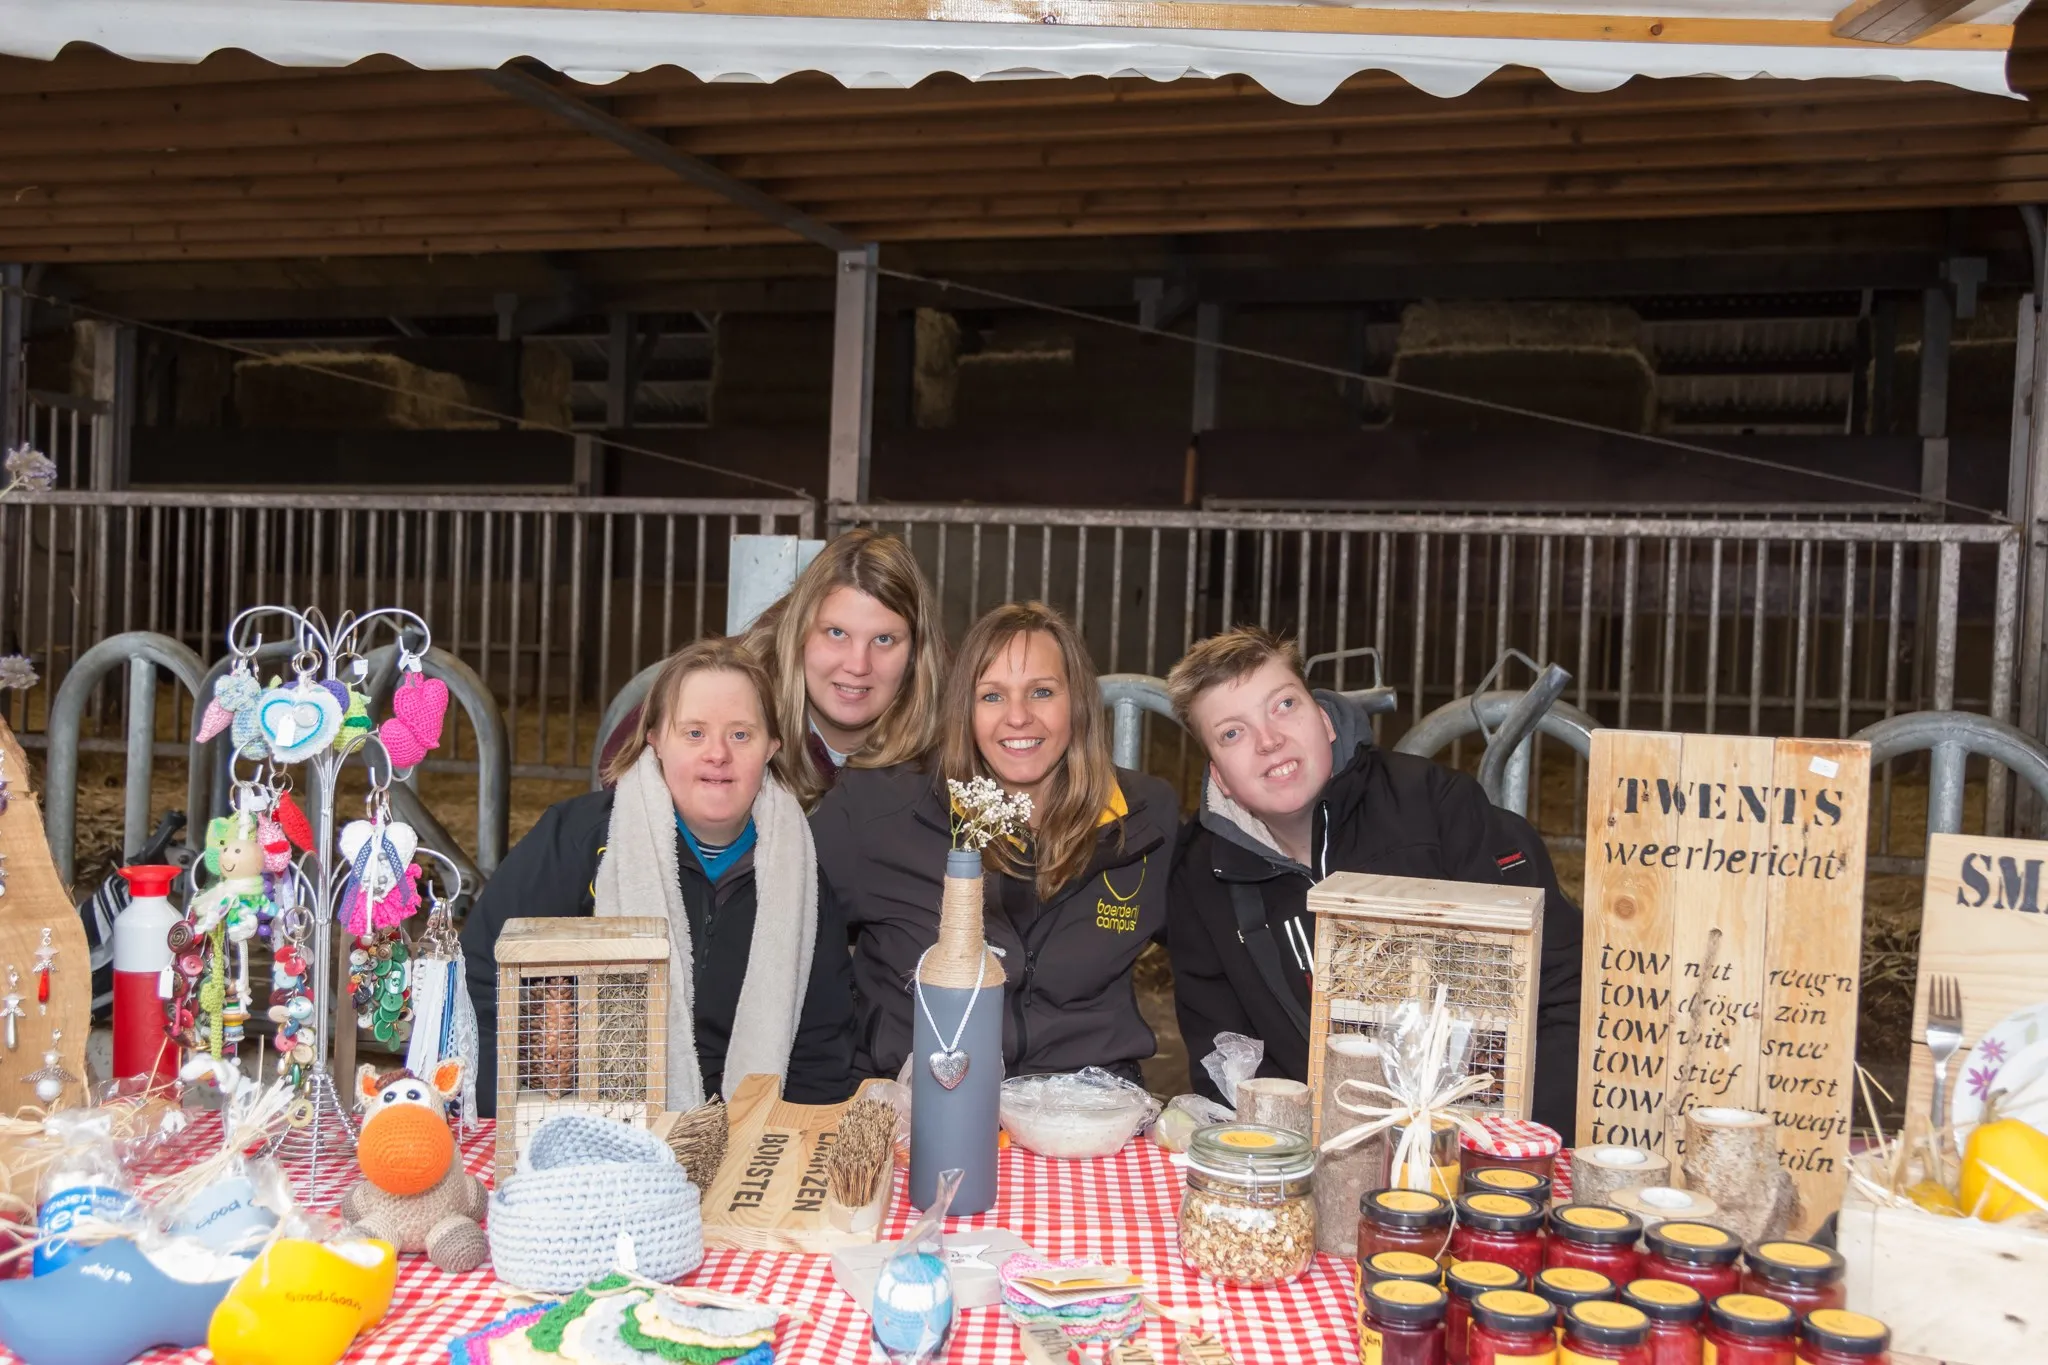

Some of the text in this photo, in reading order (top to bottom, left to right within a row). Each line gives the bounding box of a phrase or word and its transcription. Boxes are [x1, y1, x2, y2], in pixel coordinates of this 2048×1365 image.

[1617, 776, 1843, 827] TWENTS
[1956, 852, 2048, 915] SM
[1096, 898, 1141, 923] boerderij
[1096, 915, 1137, 934] campus
[1600, 943, 1671, 975] tow
[1600, 978, 1670, 1010] tow
[1596, 1012, 1669, 1045] tow
[1761, 1038, 1829, 1060] snee
[1592, 1045, 1839, 1098] tow stief vorst
[1592, 1079, 1664, 1114] tow
[1591, 1116, 1663, 1151] tow
[728, 1132, 790, 1213] BORSTEL
